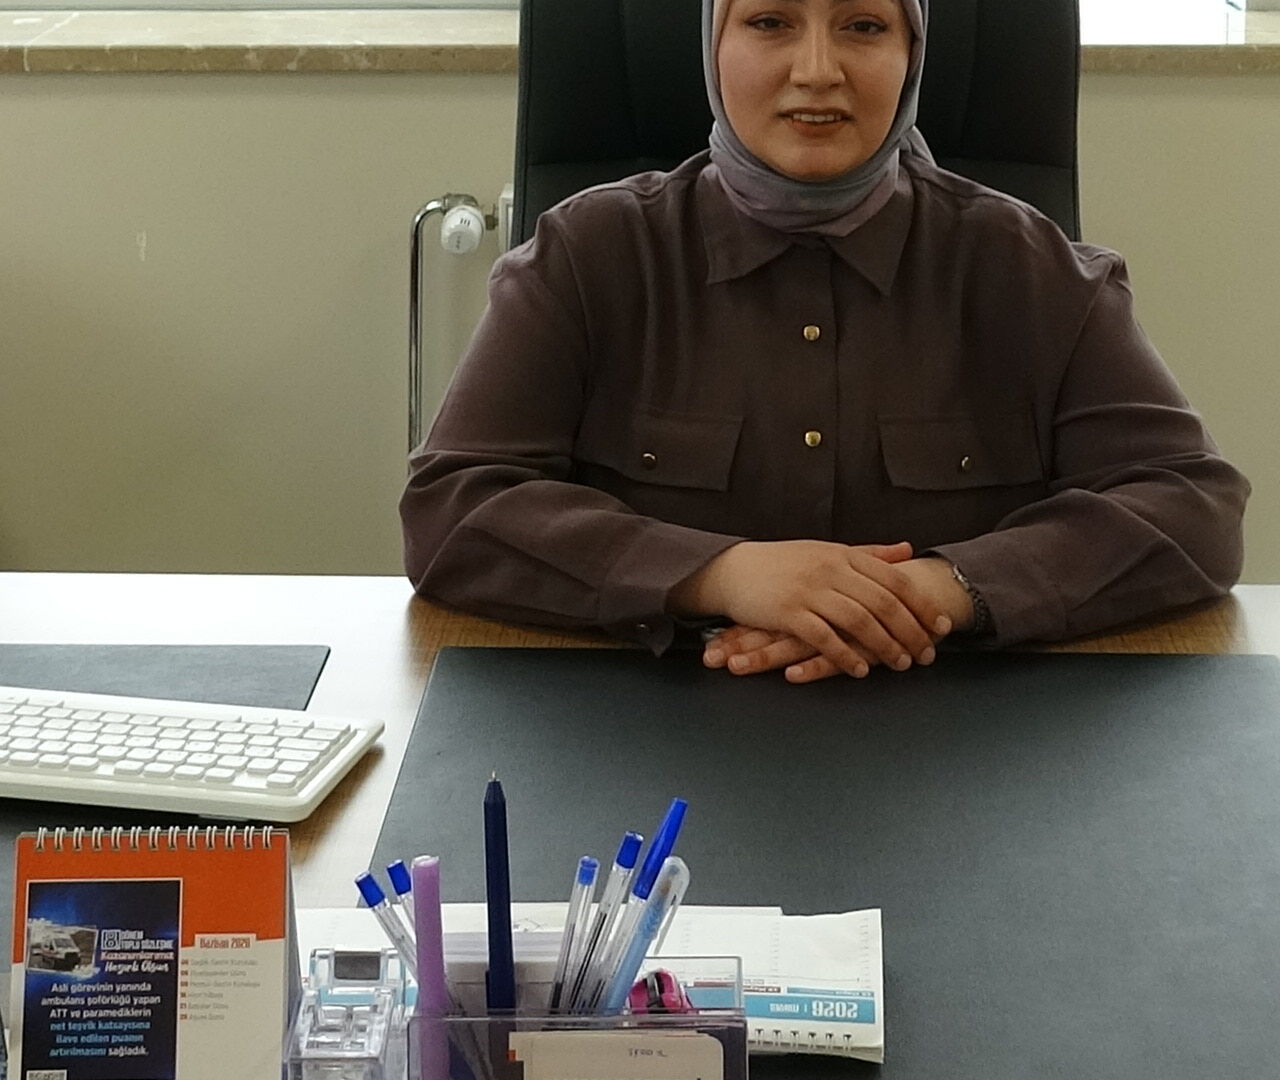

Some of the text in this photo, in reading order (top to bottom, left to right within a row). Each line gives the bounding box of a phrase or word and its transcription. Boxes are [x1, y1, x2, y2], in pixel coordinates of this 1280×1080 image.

[70, 983, 113, 993] görevinin
[116, 982, 151, 993] yanında
[41, 997, 85, 1006] ambulans
[133, 995, 161, 1005] yapan
[50, 1008, 151, 1018] ATT ve paramediklerin
